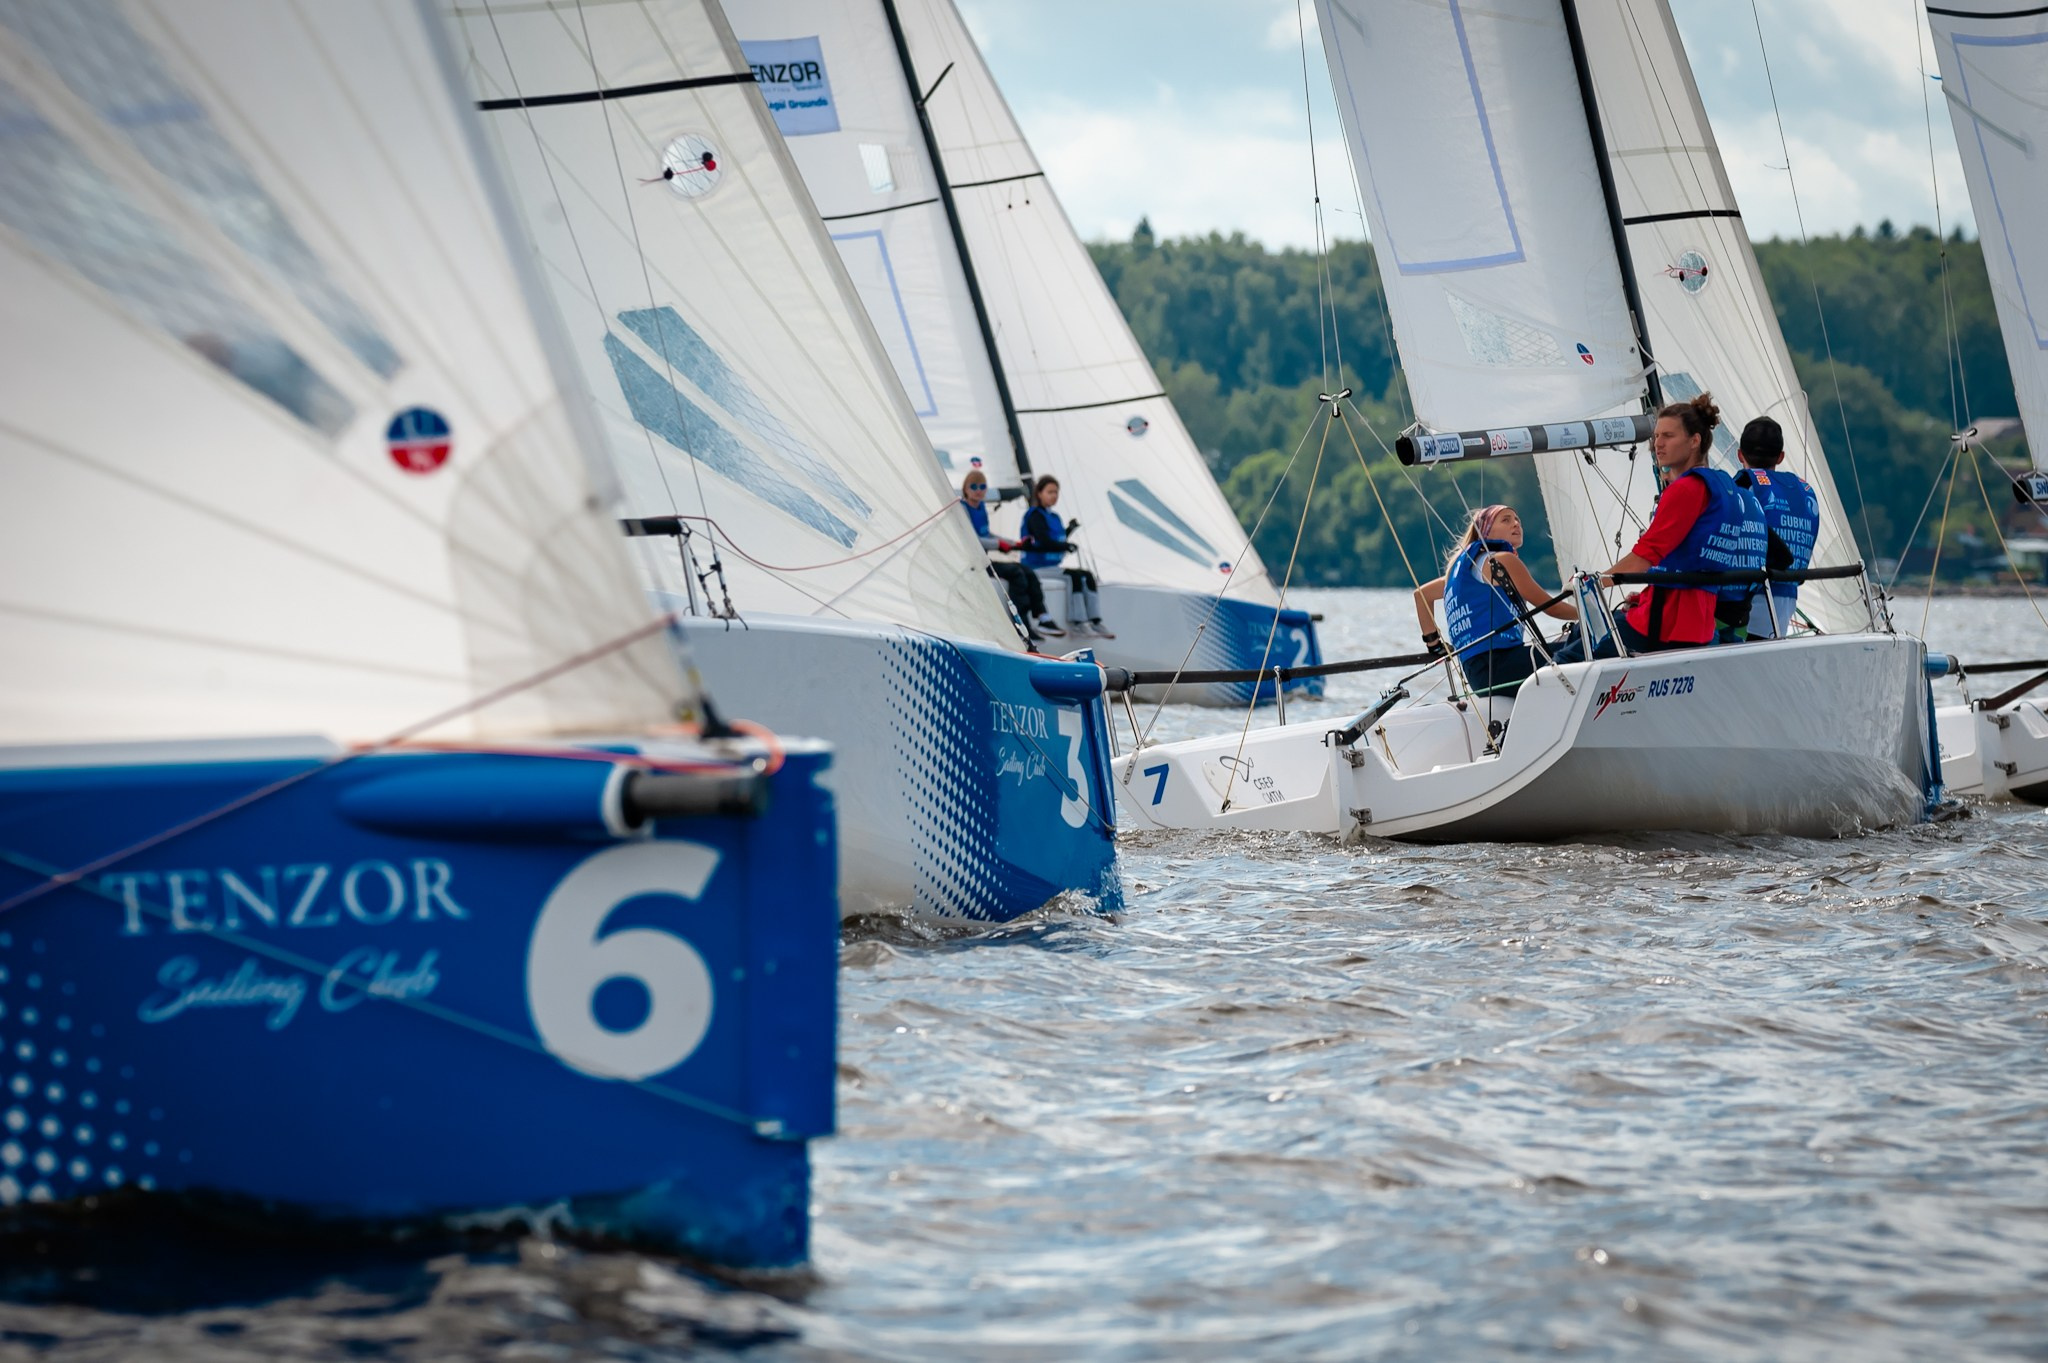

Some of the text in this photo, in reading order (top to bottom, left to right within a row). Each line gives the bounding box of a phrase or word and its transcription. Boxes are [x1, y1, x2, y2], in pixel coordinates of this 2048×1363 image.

[750, 61, 821, 83] ENZOR
[1780, 514, 1812, 532] GUBKIN
[1732, 555, 1760, 568] AILING
[1450, 617, 1472, 638] TEAM
[1648, 675, 1695, 698] RUS 7278
[990, 700, 1049, 739] TENZOR
[996, 746, 1046, 787] Sailing Club
[1057, 704, 1090, 828] 3
[1144, 763, 1170, 806] 7
[1253, 776, 1275, 790] СБЕР
[1262, 790, 1286, 804] СИТИ
[103, 857, 470, 936] TENZOR
[526, 839, 722, 1082] 6
[137, 945, 441, 1031] Sailing Club
